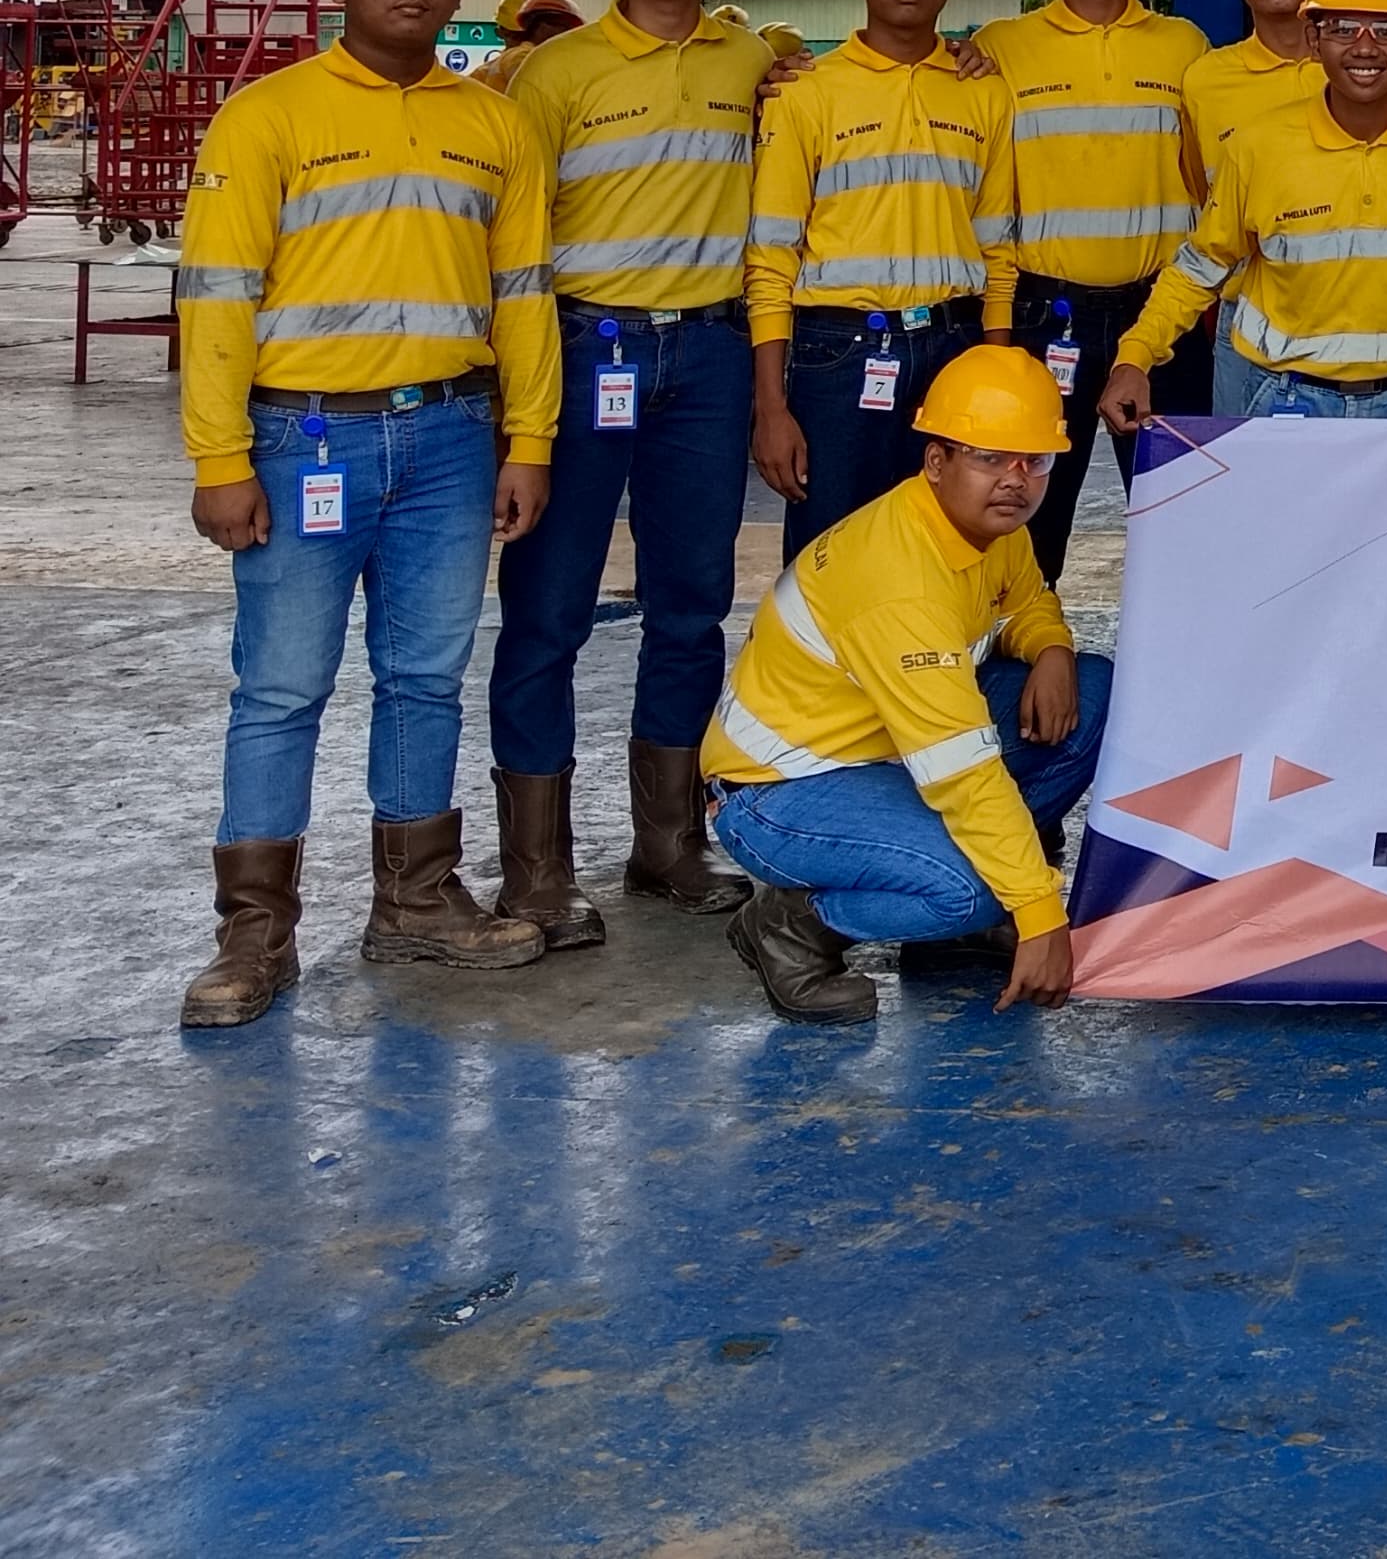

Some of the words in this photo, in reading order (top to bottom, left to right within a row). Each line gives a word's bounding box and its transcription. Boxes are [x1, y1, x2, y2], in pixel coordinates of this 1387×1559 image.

[874, 382, 886, 394] 7
[606, 396, 627, 412] 13
[311, 499, 335, 517] 17
[900, 651, 962, 669] SOBAT
